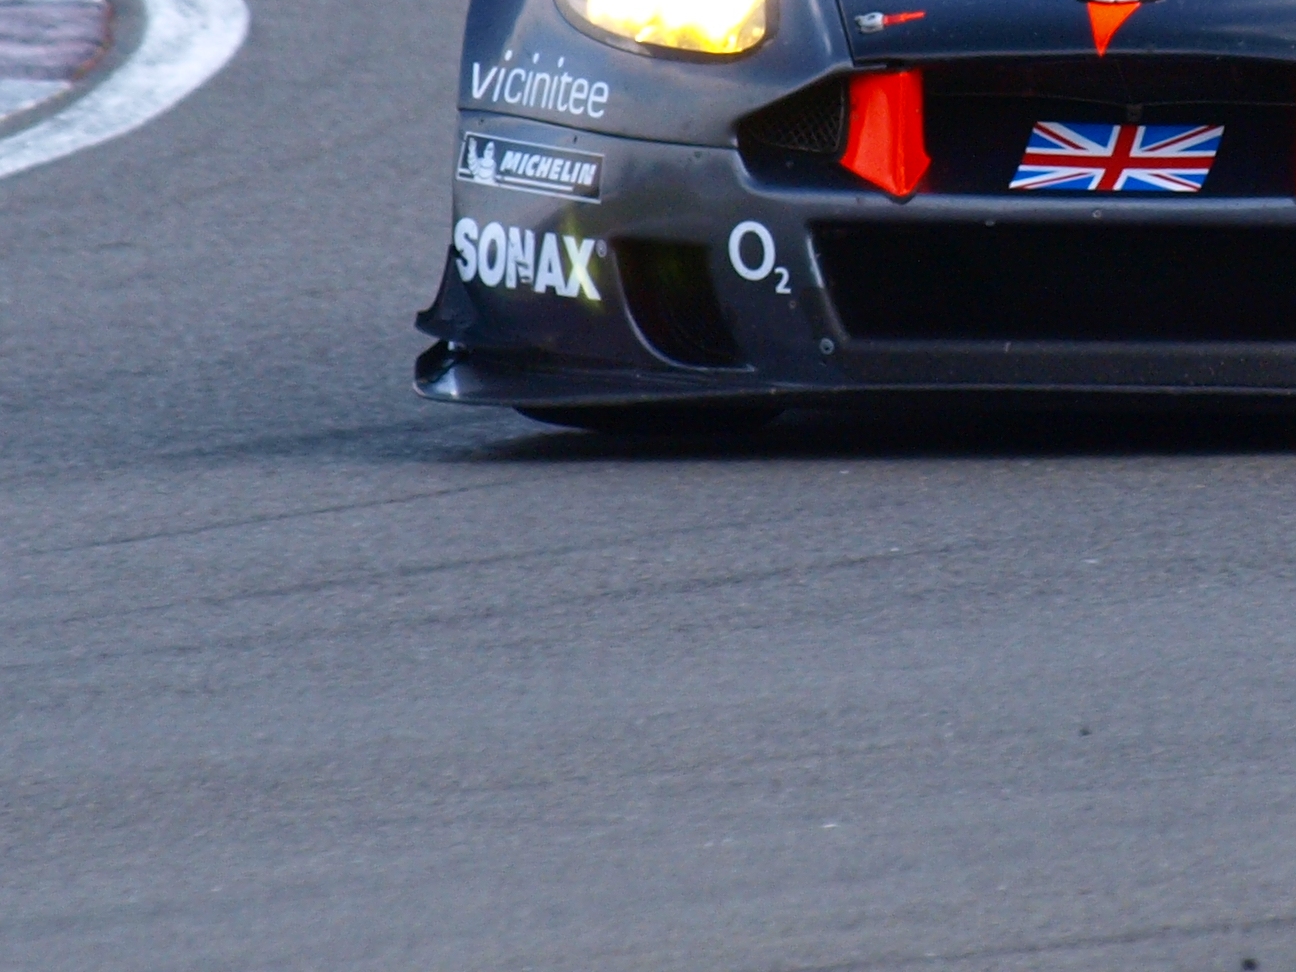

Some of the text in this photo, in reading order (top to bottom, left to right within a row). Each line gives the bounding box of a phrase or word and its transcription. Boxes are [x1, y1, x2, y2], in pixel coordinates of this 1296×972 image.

[470, 50, 609, 119] vicinitee
[499, 149, 597, 187] MICHELIN
[454, 217, 601, 301] SONAX
